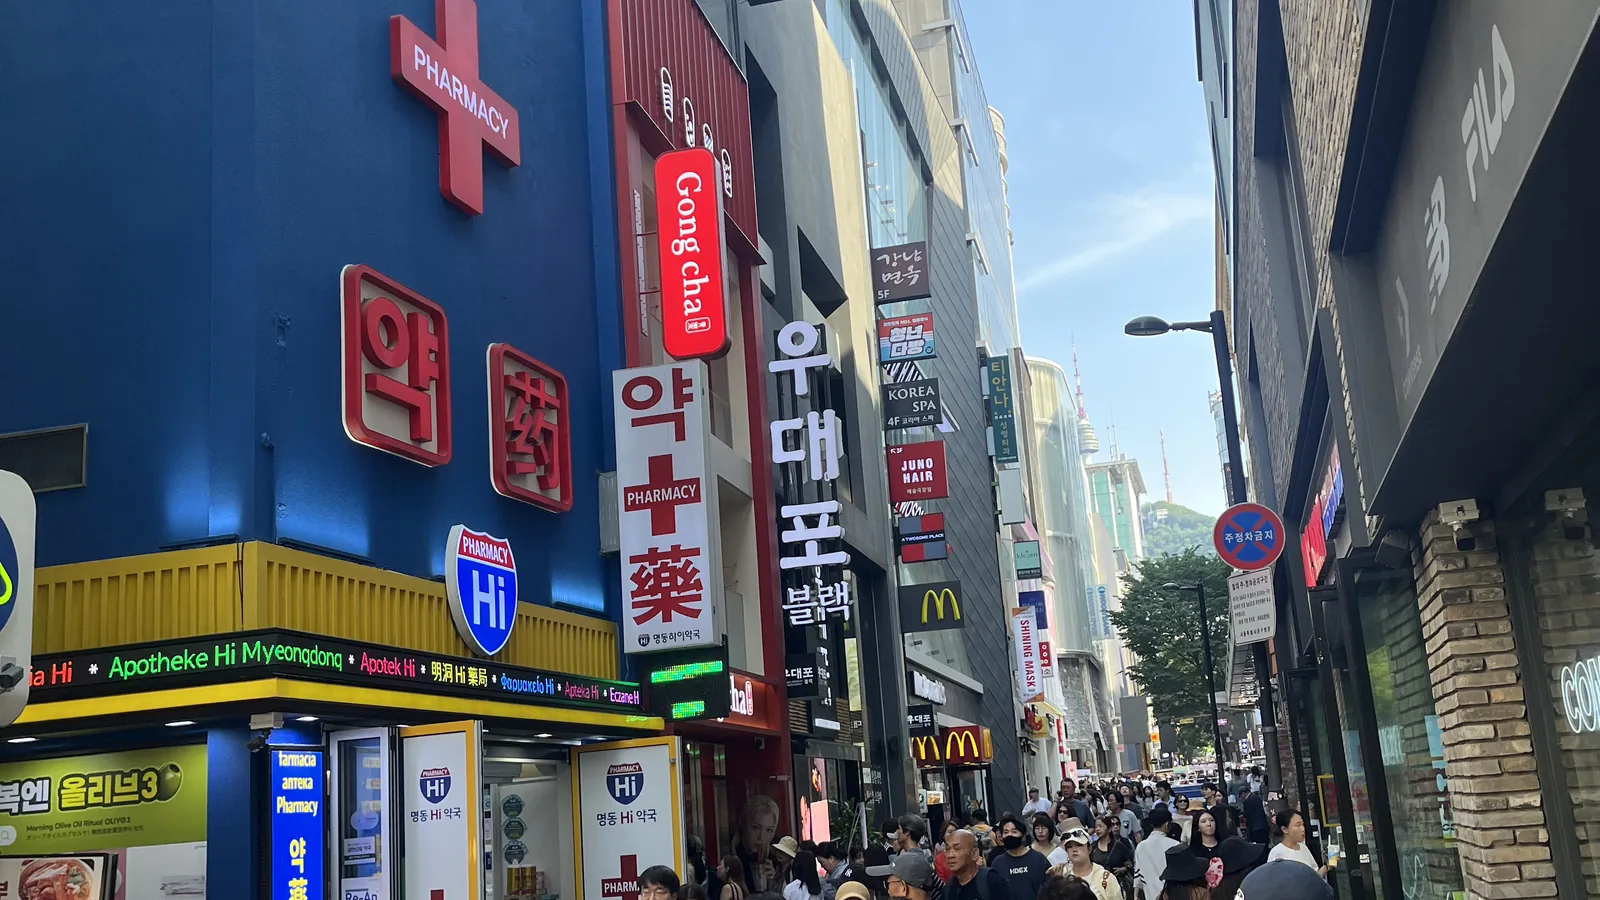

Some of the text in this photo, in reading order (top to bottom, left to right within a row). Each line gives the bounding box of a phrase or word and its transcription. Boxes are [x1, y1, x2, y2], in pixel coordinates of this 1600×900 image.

[414, 44, 509, 140] PHARMACY
[1461, 23, 1515, 202] FILA
[671, 171, 702, 256] Gong
[876, 249, 922, 268] 강남
[881, 265, 921, 286] 면옥
[681, 261, 710, 315] cha
[877, 289, 890, 299] 5F
[891, 339, 925, 357] 다방
[361, 296, 440, 444] 약
[888, 385, 935, 401] KOREA
[991, 360, 1009, 408] 티안나
[621, 368, 694, 442] 약
[912, 400, 936, 412] SPA
[505, 371, 561, 490] 药
[887, 417, 900, 426] 4F
[902, 416, 920, 425] 코리아
[768, 320, 851, 570] 우대포
[901, 457, 933, 471] JUNO
[903, 470, 933, 484] HAIR
[627, 484, 696, 506] PHARMACY
[905, 534, 929, 542] TWOSOME
[1225, 530, 1273, 544] 주정차금지
[463, 536, 509, 564] PHARMACY
[628, 545, 703, 625] 藥
[471, 570, 506, 630] Hi
[782, 581, 851, 626] 블랙
[1020, 619, 1033, 657] SHINING
[108, 640, 343, 680] Apotheke Hi Myeongdong
[360, 651, 416, 677] Apotek Hi
[52, 661, 72, 685] Hi
[431, 662, 488, 688] 明洞 Hi 藥局
[1024, 661, 1036, 687] MASK
[545, 677, 554, 695] Hi
[564, 681, 599, 701] Apteka Hi
[610, 687, 634, 704] Eczane
[422, 769, 449, 777] PHARMACY
[609, 764, 640, 773] PHARMACY
[60, 771, 158, 808] 올리브3
[426, 779, 444, 798] Hi
[614, 776, 636, 798] Hi
[277, 796, 318, 817] Pharmacy
[410, 807, 462, 823] 명동 Hi 약국
[596, 808, 657, 827] 명동 Hi 약국
[26, 824, 53, 833] Morning
[54, 822, 72, 830] Olive
[73, 820, 82, 828] Oil
[84, 819, 103, 828] Ritual
[289, 837, 307, 874] 약
[604, 881, 640, 894] PHARM
